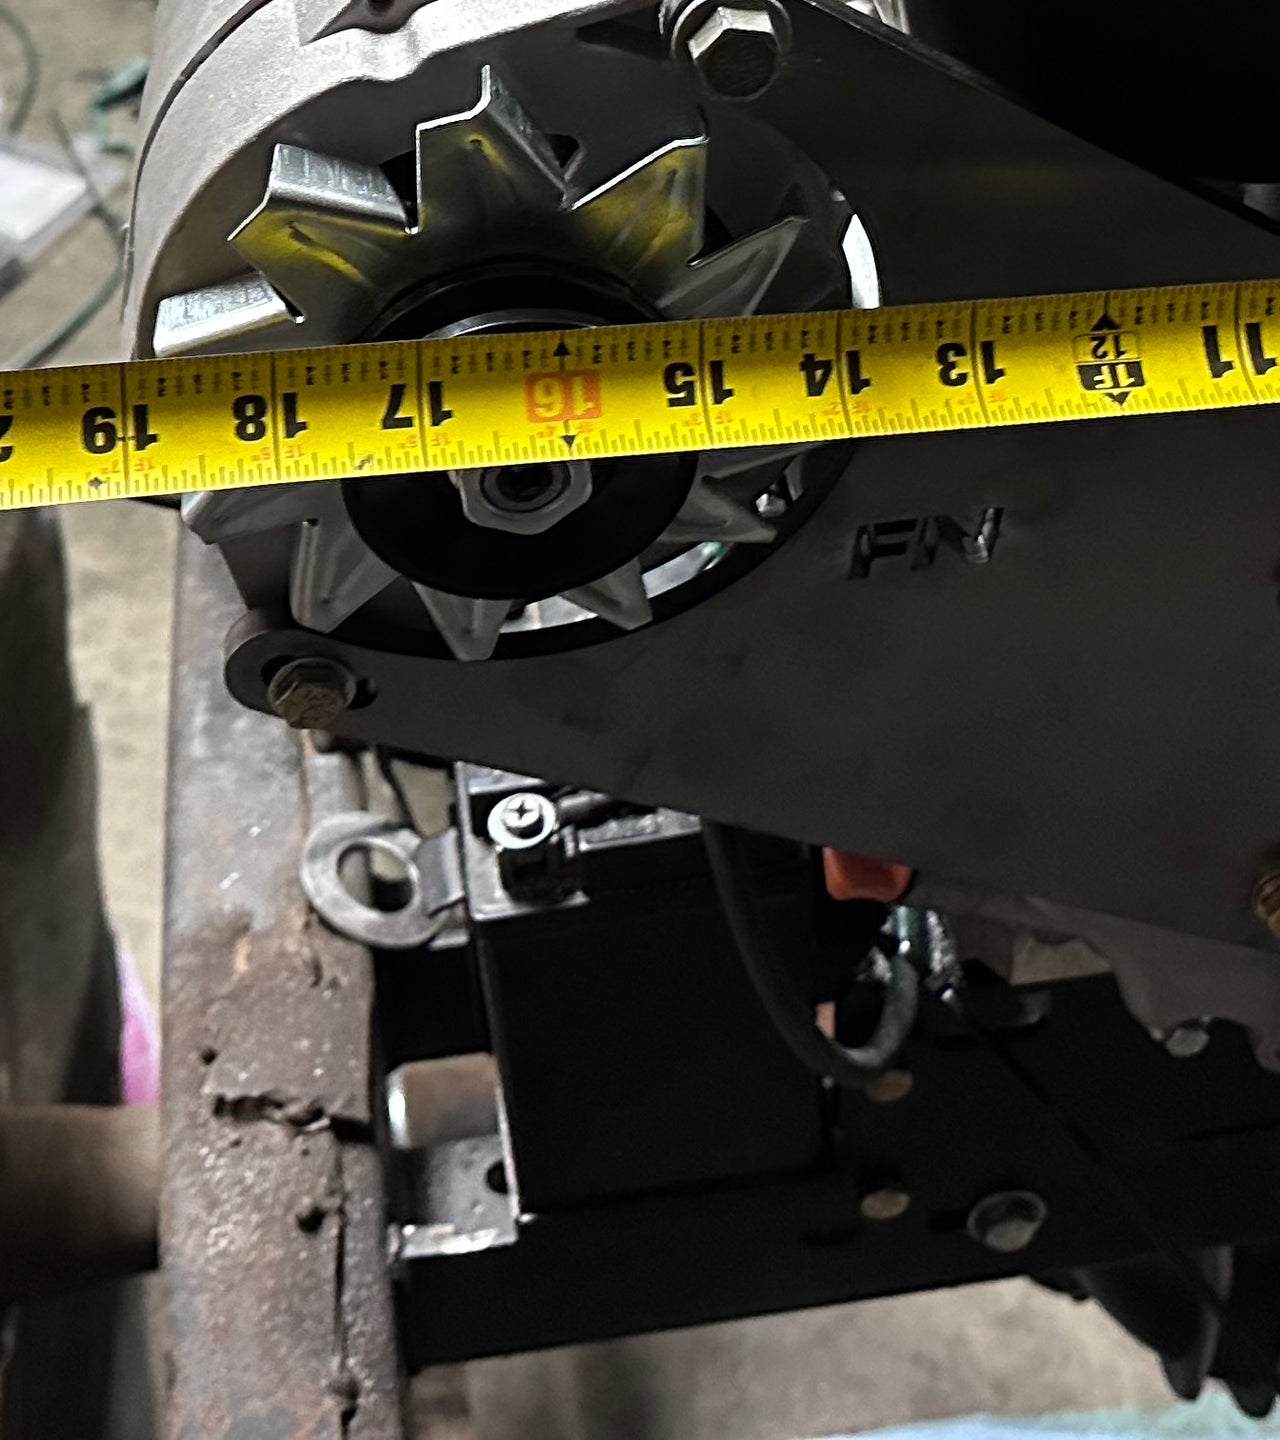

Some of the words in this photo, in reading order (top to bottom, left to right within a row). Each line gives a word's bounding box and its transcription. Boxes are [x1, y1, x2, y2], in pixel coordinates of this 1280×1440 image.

[936, 340, 1006, 388] 13
[1090, 334, 1129, 360] 12
[1201, 322, 1278, 379] 11
[533, 375, 596, 419] 16
[663, 360, 734, 408] 15
[800, 350, 871, 397] 14
[1093, 363, 1136, 389] 1F
[81, 403, 159, 455] 19
[232, 391, 308, 442] 18
[380, 380, 454, 430] 17
